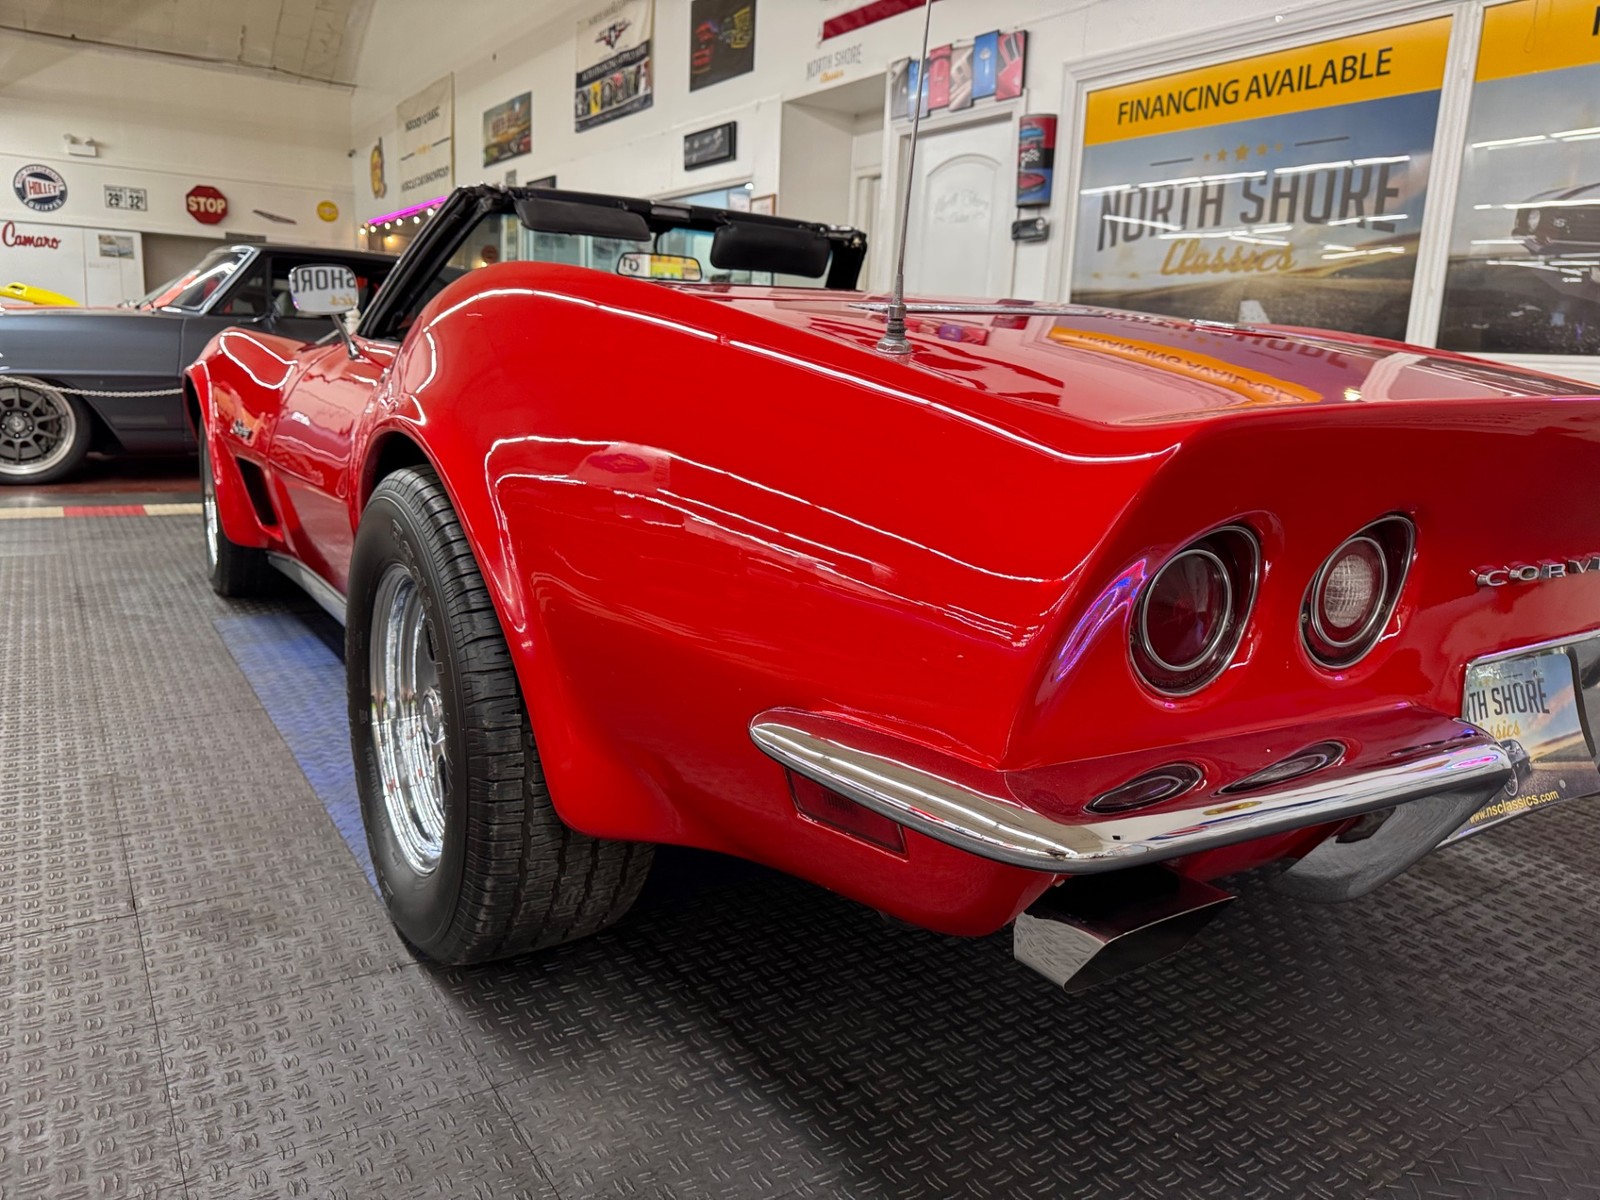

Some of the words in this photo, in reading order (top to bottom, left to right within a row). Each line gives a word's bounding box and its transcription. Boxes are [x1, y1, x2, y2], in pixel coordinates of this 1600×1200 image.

[1117, 79, 1239, 125] FINANCING
[1244, 47, 1393, 101] AVAILABLE
[28, 180, 57, 196] HOLLEY
[188, 196, 226, 214] STOP
[1097, 177, 1225, 252] NORTH
[1240, 162, 1400, 233] SHORE
[2, 221, 61, 249] Camaro
[1160, 238, 1297, 276] Classics
[1491, 678, 1550, 715] SHORE
[1470, 790, 1559, 824] www.nsclassics.com
